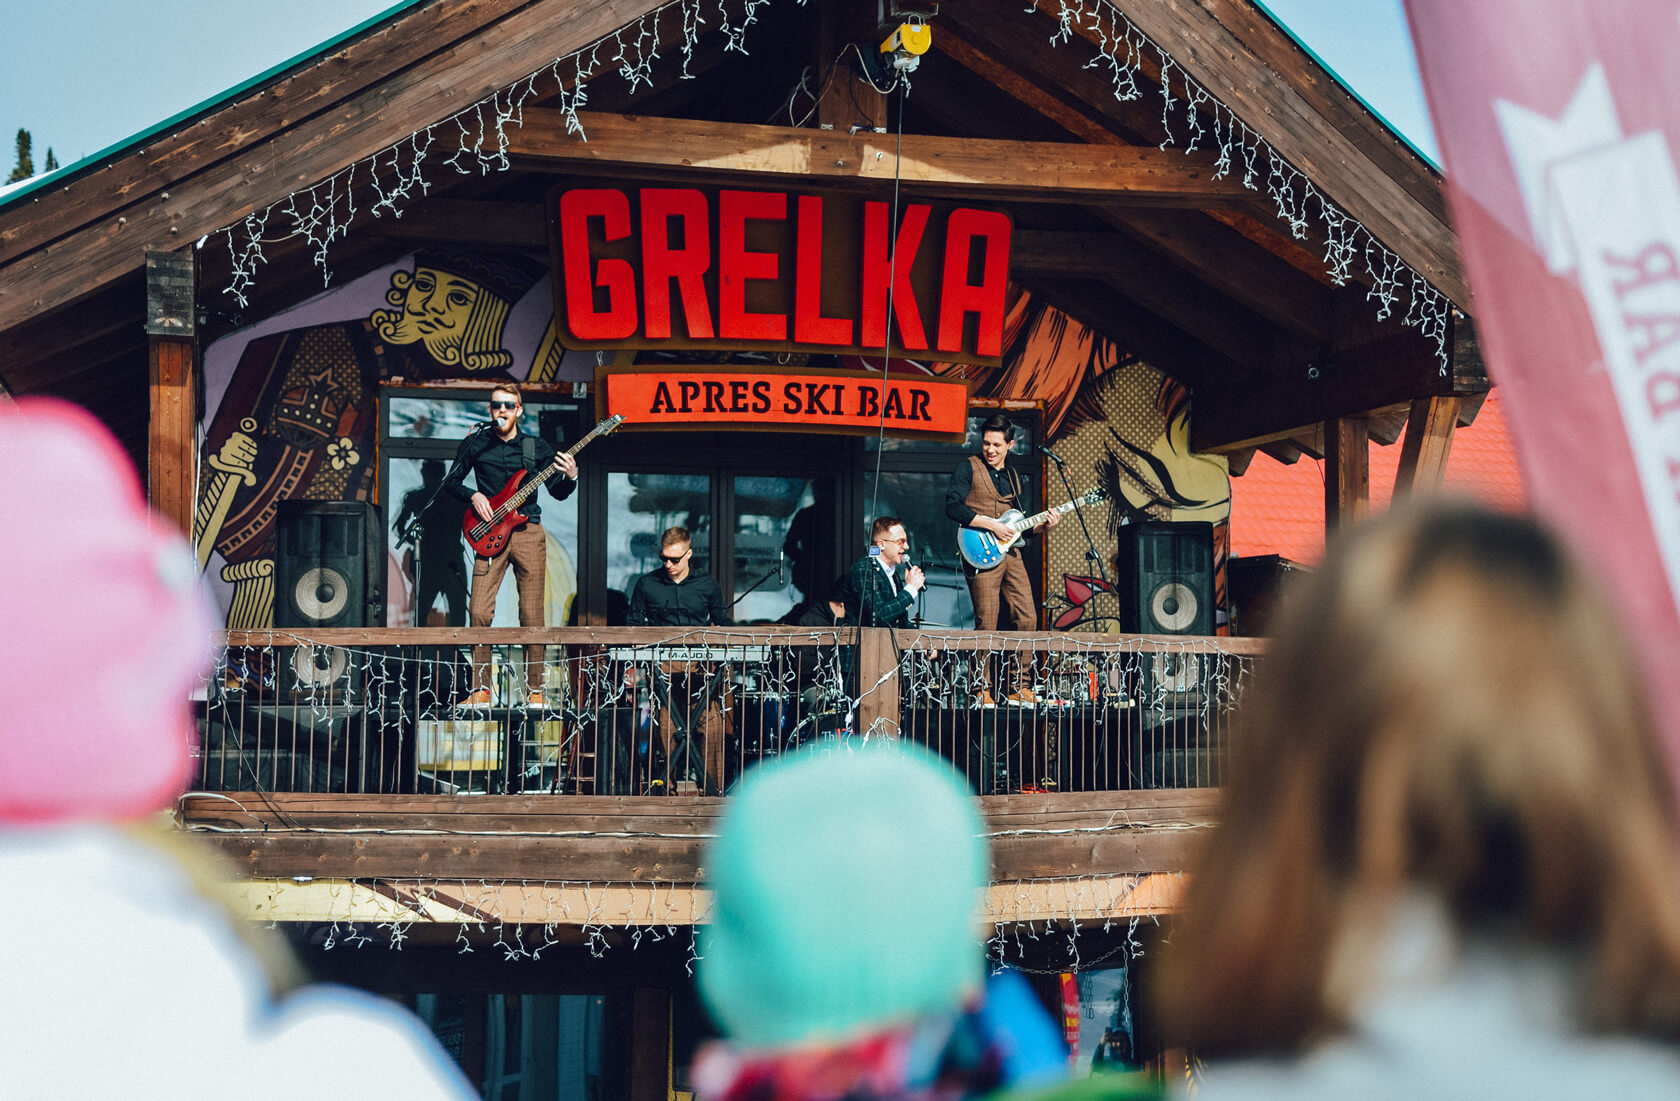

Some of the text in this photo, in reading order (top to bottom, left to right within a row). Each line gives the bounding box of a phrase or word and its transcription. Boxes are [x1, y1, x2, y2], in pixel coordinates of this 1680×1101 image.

[560, 188, 1011, 357] GRELKA
[650, 381, 932, 421] APRES SKI BAR
